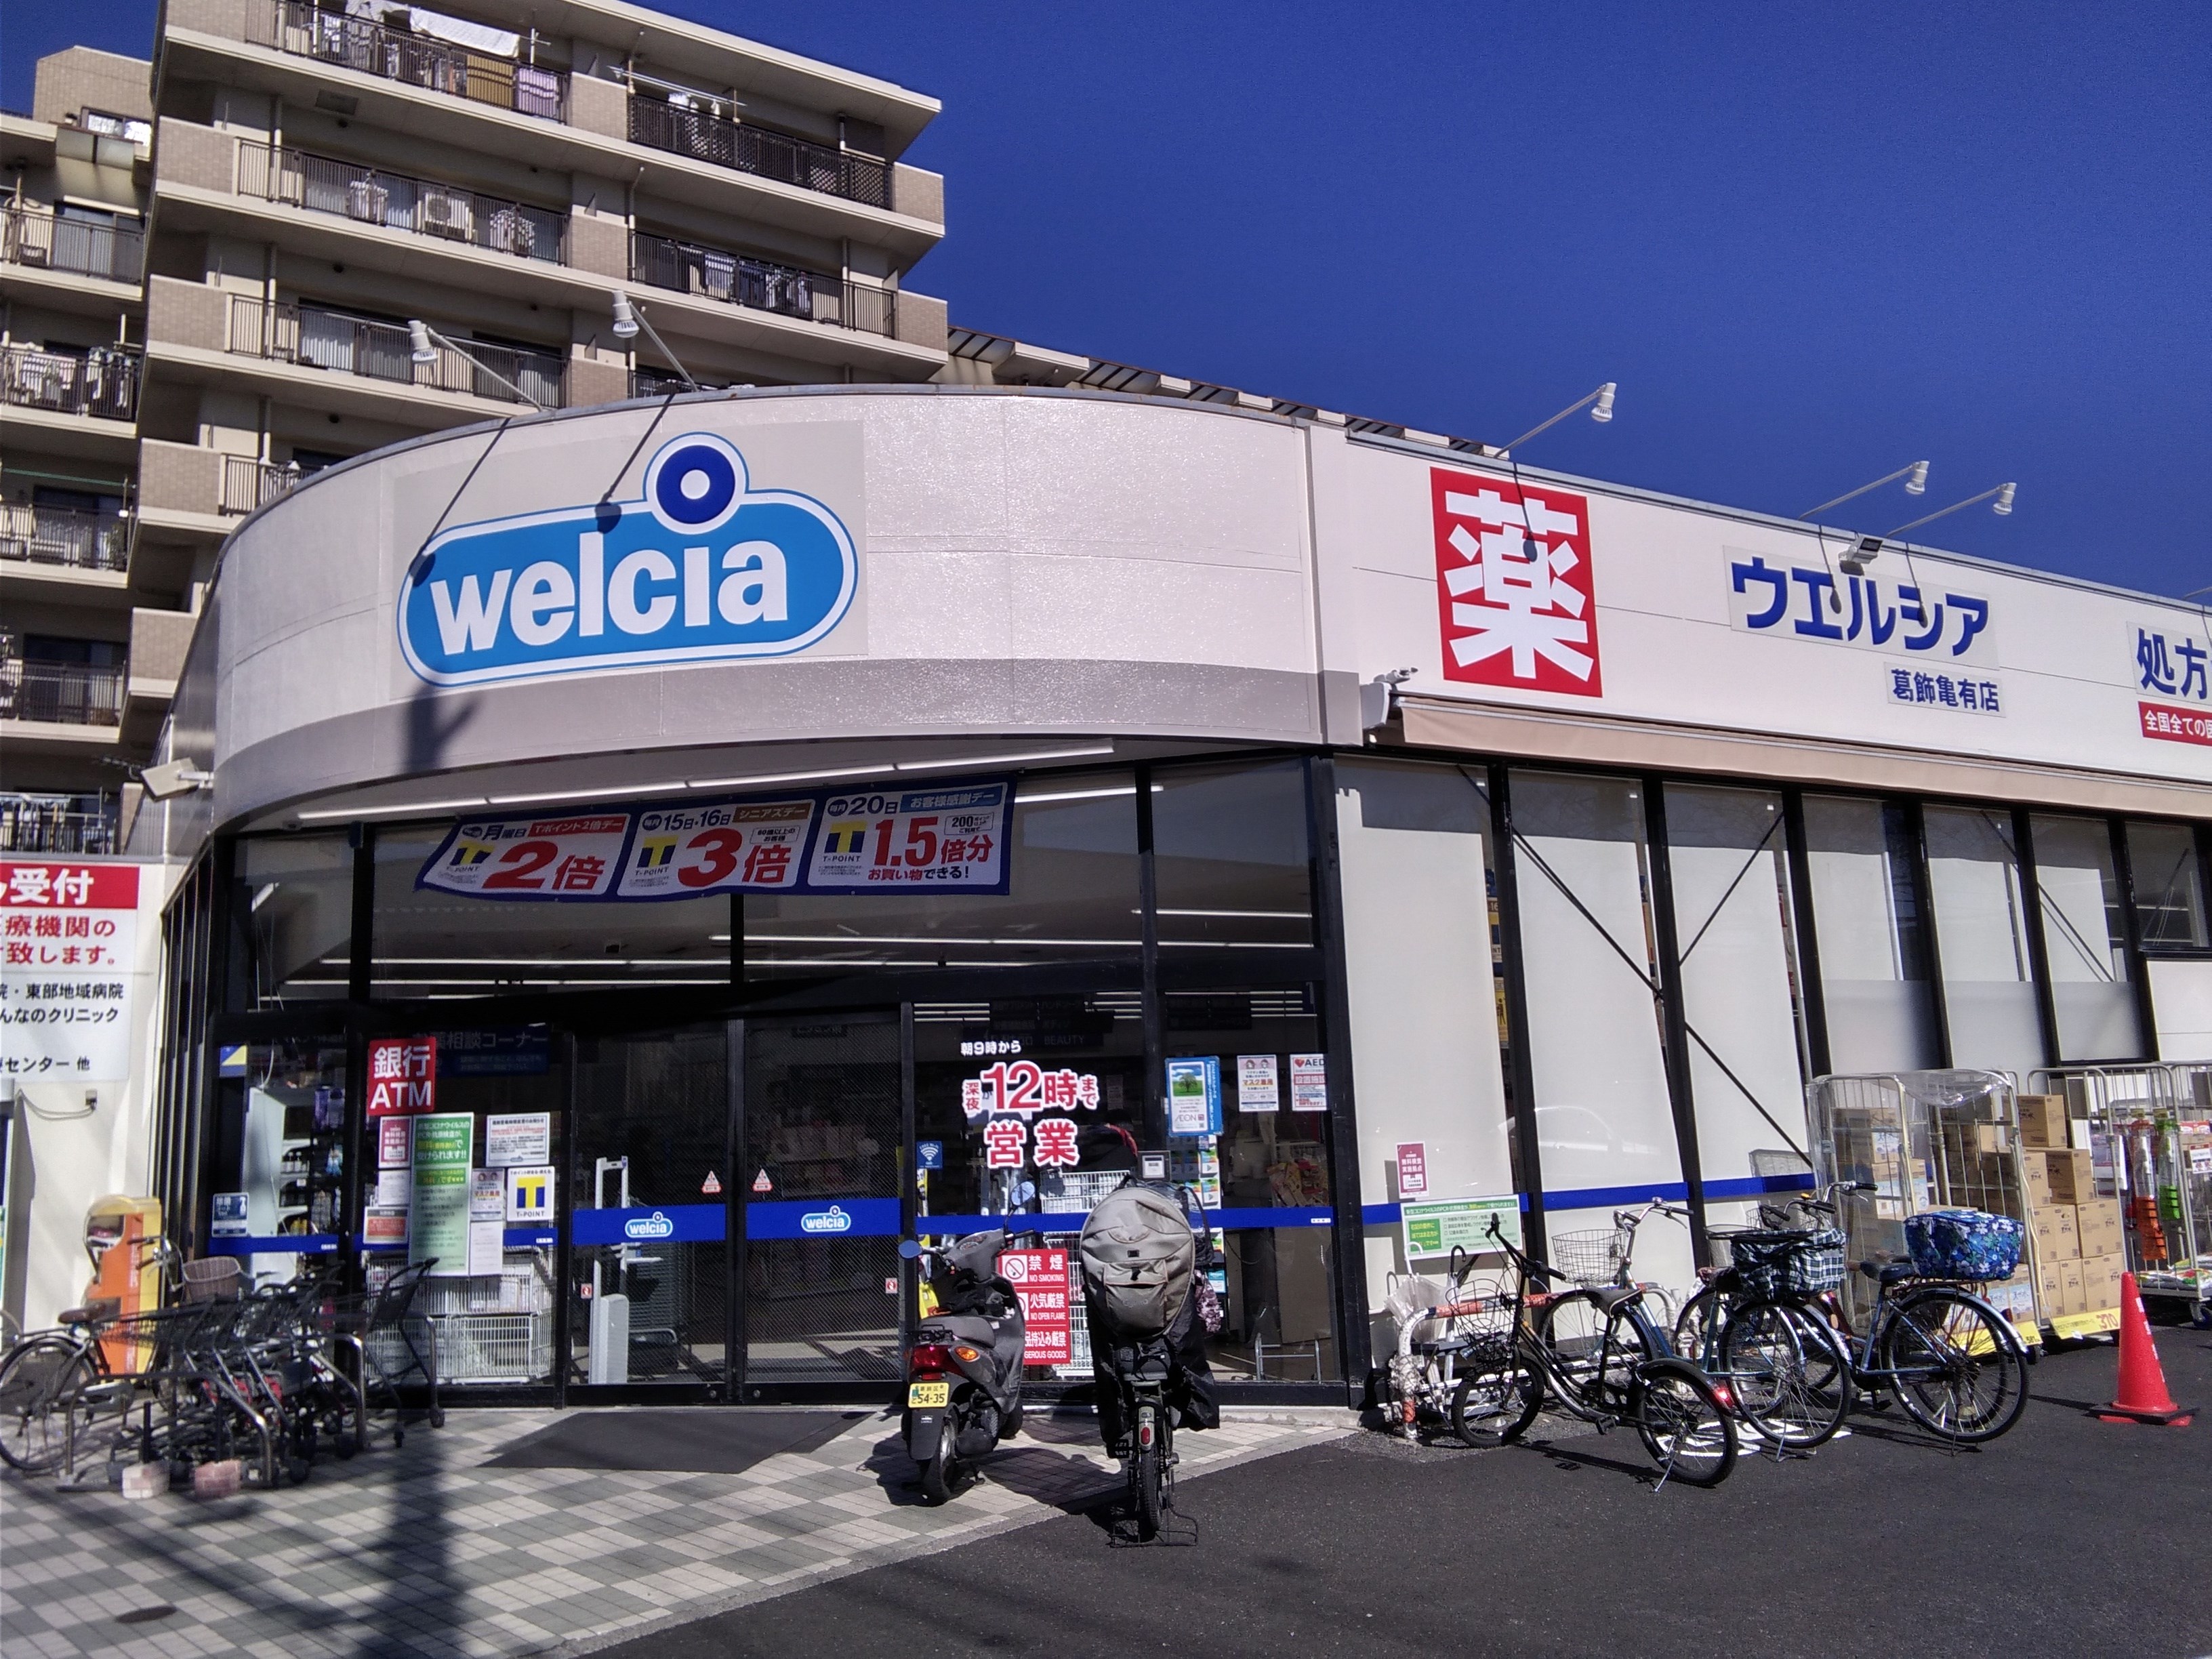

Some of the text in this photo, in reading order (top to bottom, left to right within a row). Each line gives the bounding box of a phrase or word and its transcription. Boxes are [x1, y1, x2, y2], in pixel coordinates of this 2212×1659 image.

[430, 531, 787, 655] welcia
[1444, 488, 1593, 682] 薬
[1732, 556, 1988, 656] ウエルシア
[2137, 628, 2212, 699] 処方
[1891, 668, 2000, 713] 葛飾亀有店
[848, 795, 899, 815] 20日
[911, 792, 994, 808] お客様感謝デー
[481, 840, 606, 890] 2倍
[678, 827, 792, 887] 3倍
[0, 914, 116, 938] 療機関の
[0, 941, 115, 965] 致します。
[960, 1040, 1022, 1057] 朝9時から
[0, 1055, 90, 1073] センター 他
[374, 1046, 430, 1079] 銀行
[1305, 1058, 1325, 1067] AED
[370, 1080, 432, 1109] ATM
[965, 1081, 981, 1111] 深夜
[983, 1063, 1078, 1110] 12時
[1081, 1077, 1098, 1107] まで
[986, 1122, 1078, 1166] 営業
[629, 1222, 668, 1235] welcia
[805, 1216, 845, 1230] welcia
[1029, 1254, 1063, 1271] 禁煙
[1029, 1273, 1065, 1282] NO SMOKING
[1029, 1292, 1065, 1309] 火気厳禁
[1050, 1312, 1066, 1320] FLAME
[1047, 1350, 1067, 1359] GOODS
[917, 1393, 945, 1404] 54-35
